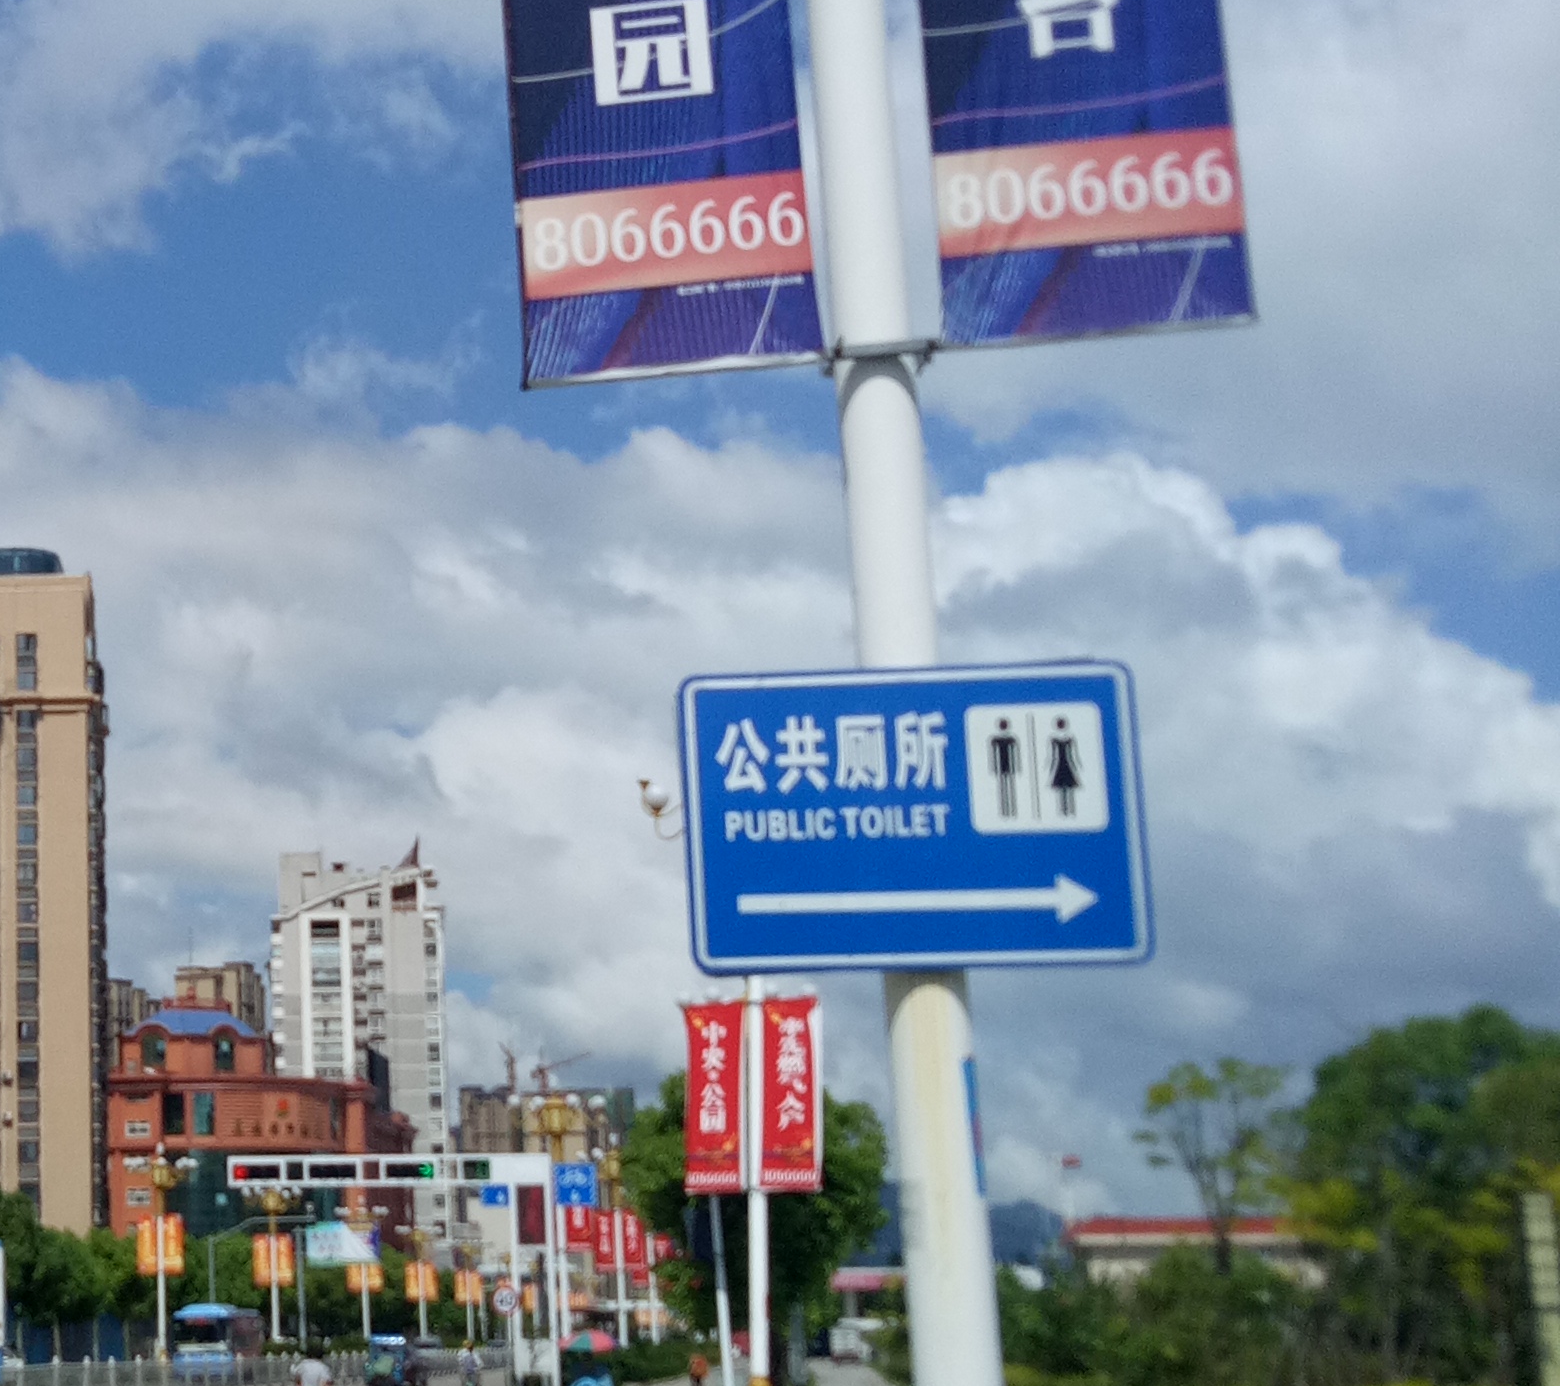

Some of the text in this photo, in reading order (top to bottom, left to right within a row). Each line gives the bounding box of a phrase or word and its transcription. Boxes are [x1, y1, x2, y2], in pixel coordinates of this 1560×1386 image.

[946, 148, 1234, 230] 8066666
[533, 190, 805, 272] 8066666
[713, 710, 950, 795] 公共厕所
[724, 802, 951, 843] PUBLIC TOILET
